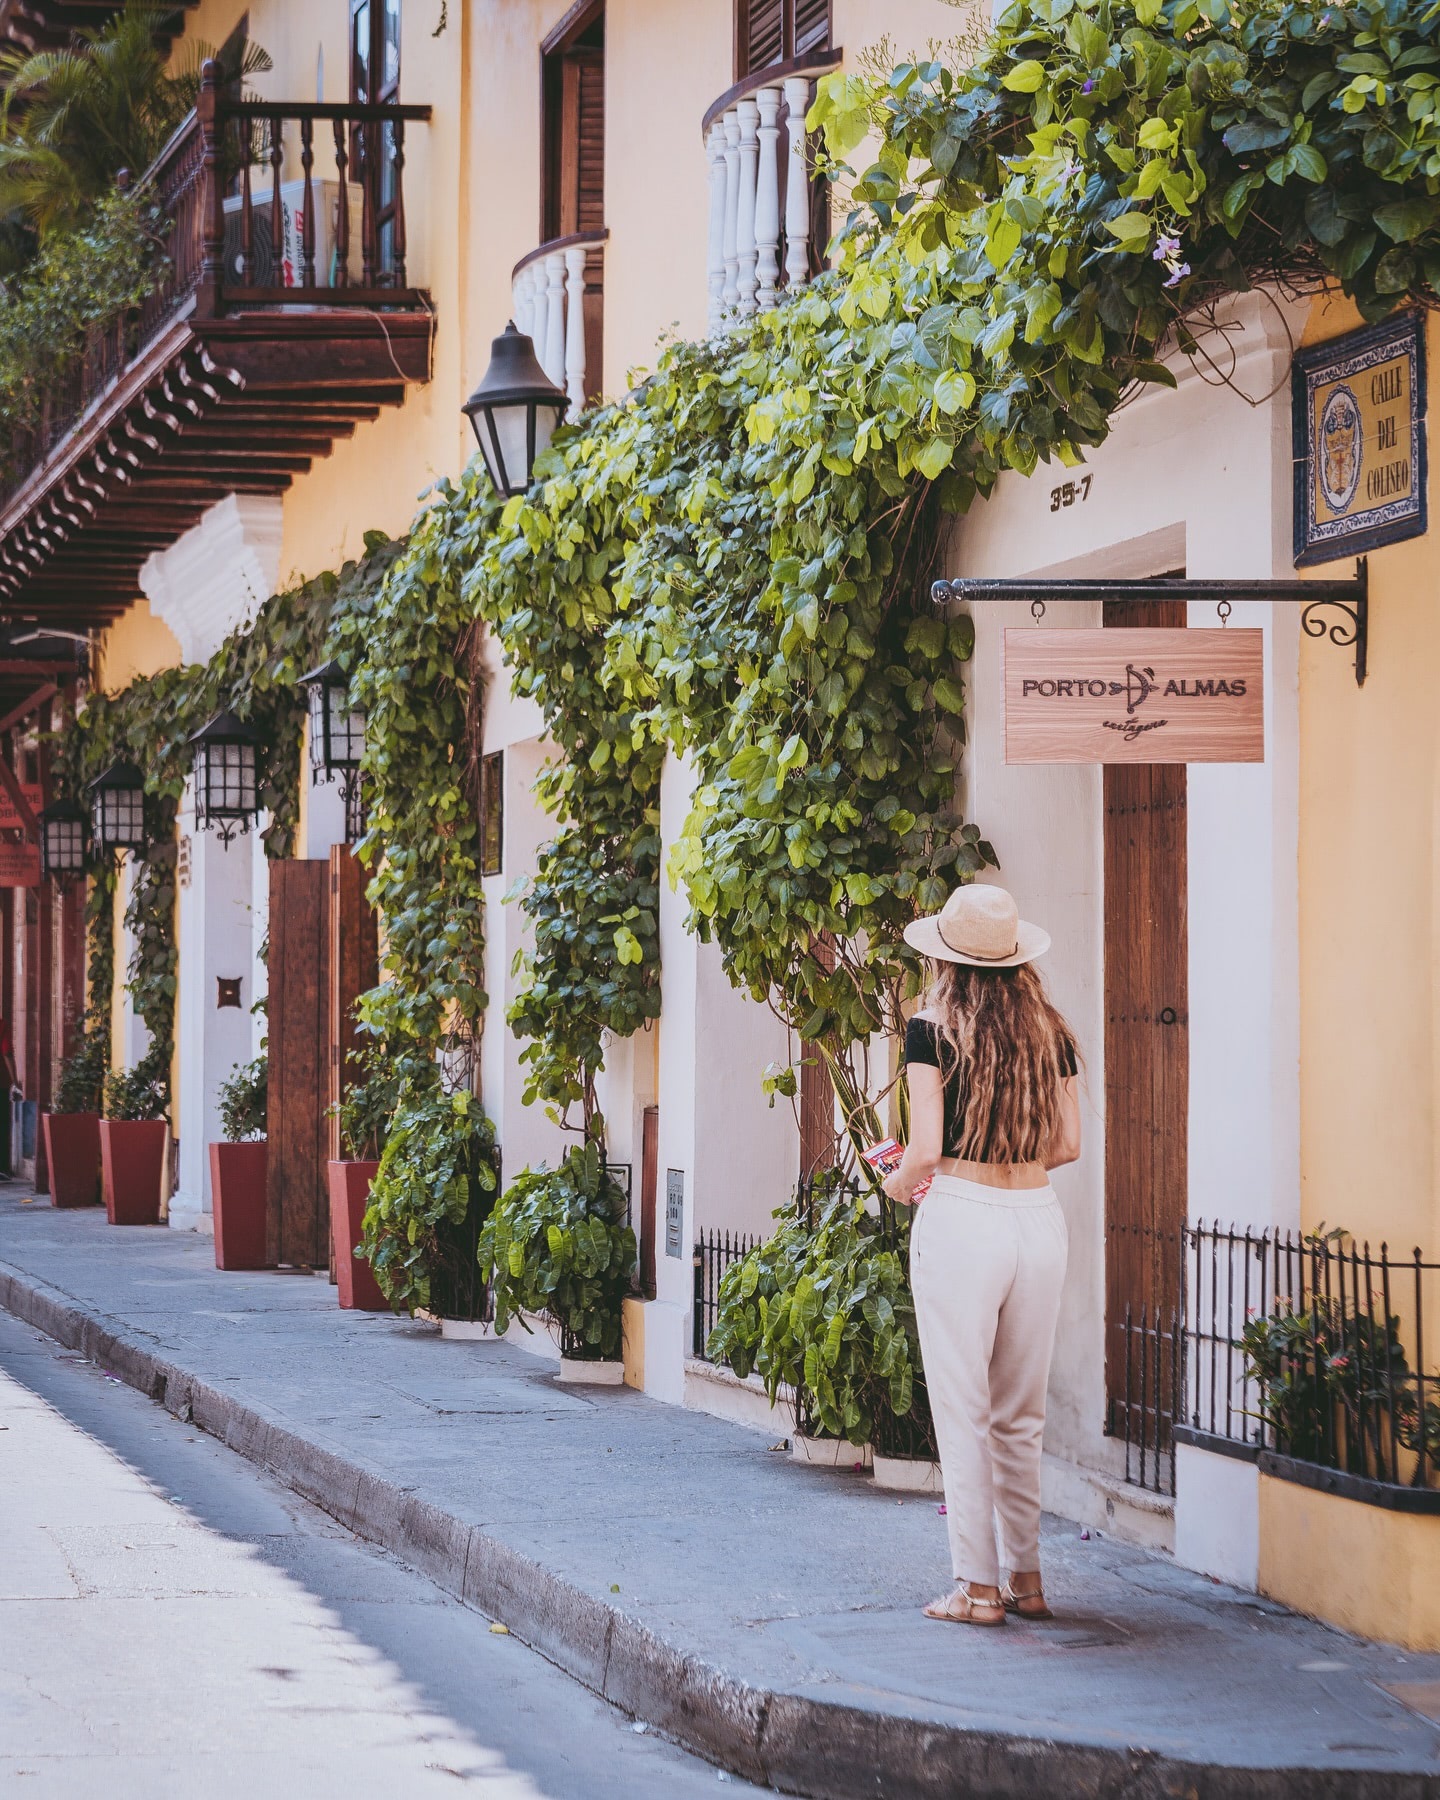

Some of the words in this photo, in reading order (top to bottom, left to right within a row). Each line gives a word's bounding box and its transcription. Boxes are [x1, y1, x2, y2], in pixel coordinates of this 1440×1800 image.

[1371, 366, 1402, 405] CALLE
[1377, 416, 1397, 450] DEL
[1050, 472, 1094, 512] 35-7
[1367, 459, 1409, 500] COLISEO
[1022, 679, 1107, 697] PORTO
[1163, 679, 1247, 697] ALMAS
[1102, 716, 1168, 741] cartagena
